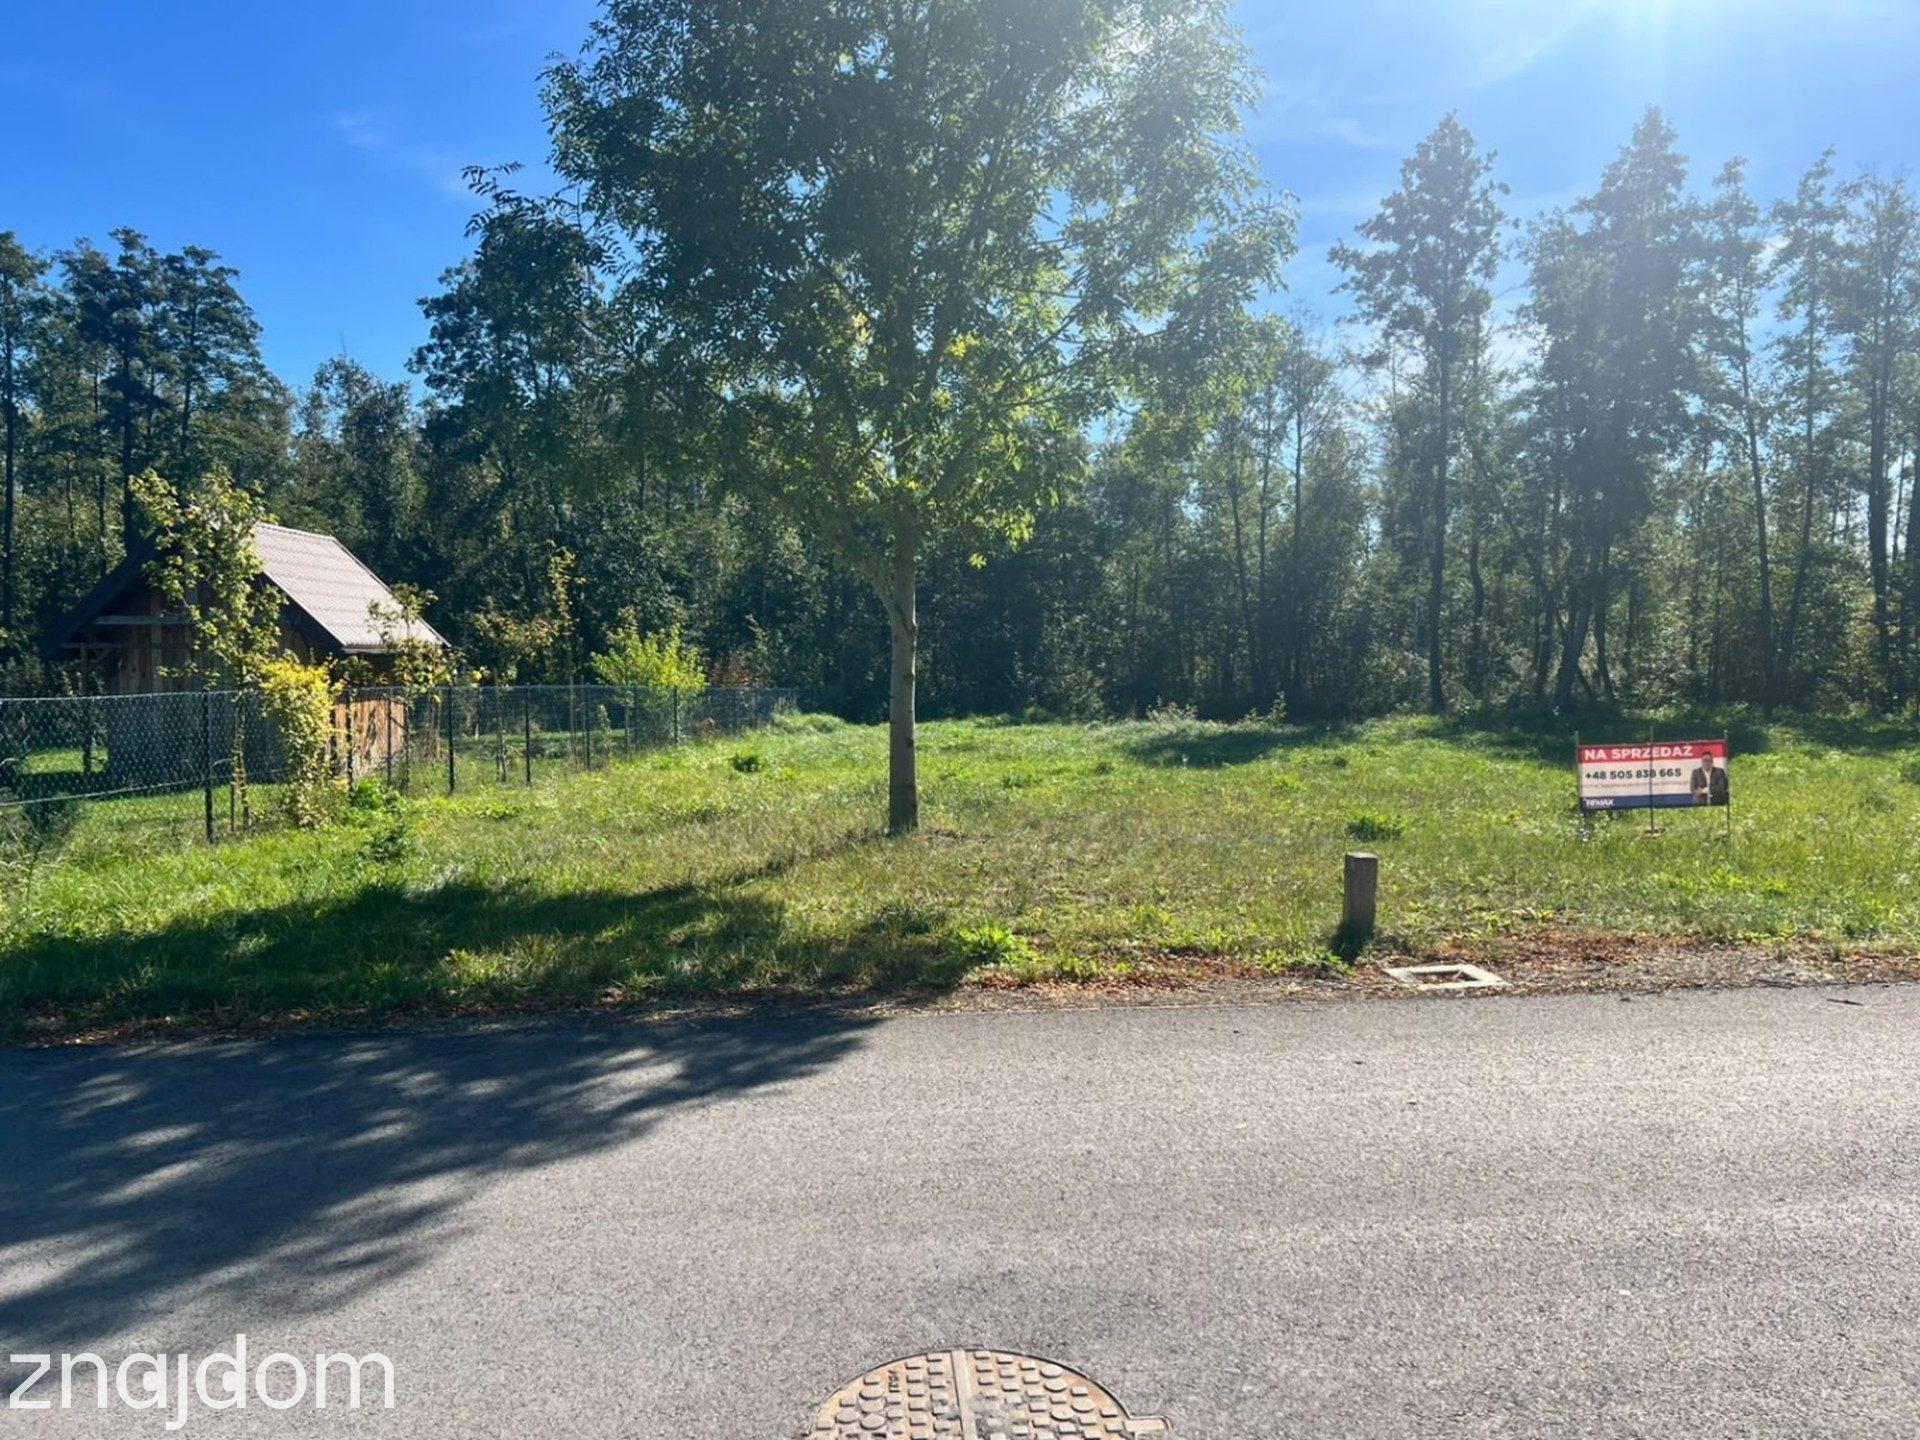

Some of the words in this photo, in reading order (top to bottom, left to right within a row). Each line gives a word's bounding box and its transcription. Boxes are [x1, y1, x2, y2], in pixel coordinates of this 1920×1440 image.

[1584, 749, 1607, 760] NA
[1585, 771, 1607, 780] +48
[1610, 770, 1634, 780] 505
[1659, 768, 1682, 778] 665
